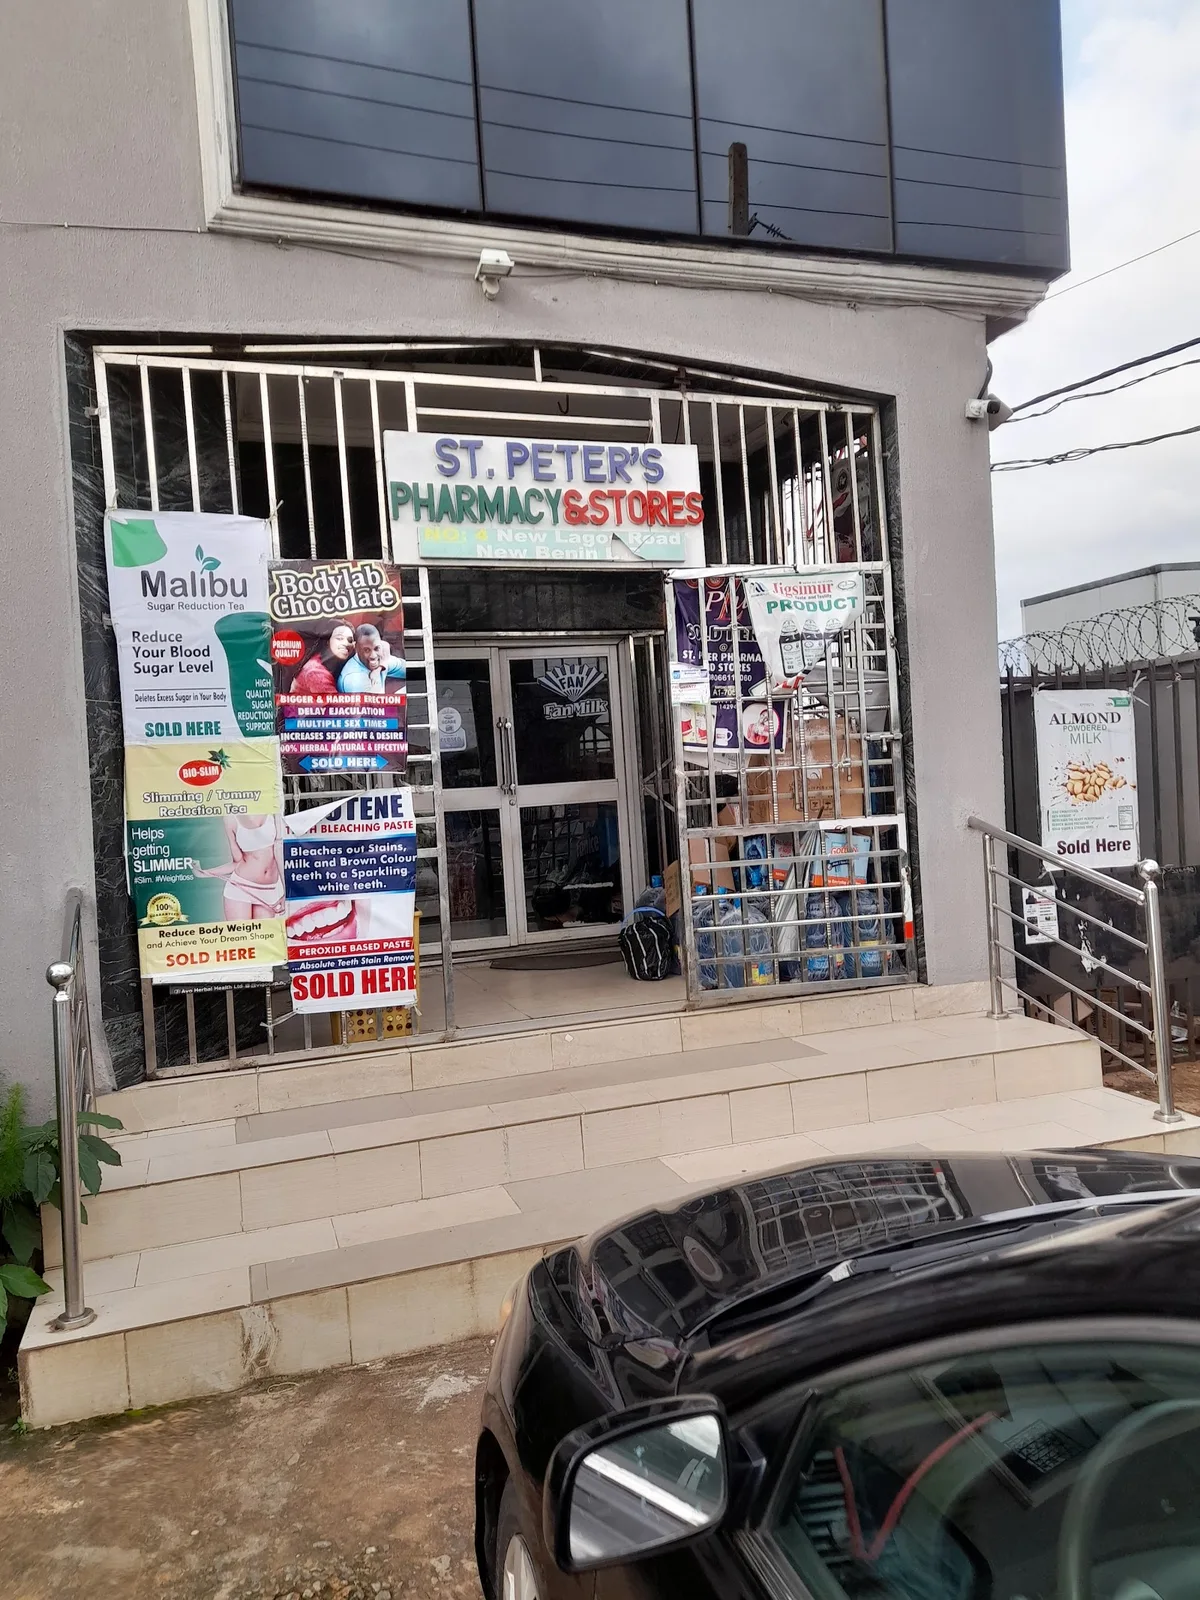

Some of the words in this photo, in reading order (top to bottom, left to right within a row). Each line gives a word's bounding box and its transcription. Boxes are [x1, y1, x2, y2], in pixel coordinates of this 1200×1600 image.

[435, 438, 494, 479] ST.
[505, 441, 665, 483] PETER'S
[475, 528, 488, 541] 4
[497, 529, 548, 543] New
[628, 533, 681, 545] Road
[477, 544, 529, 558] New
[536, 547, 598, 560] Benin
[140, 570, 248, 598] Malibu
[279, 566, 381, 597] Bodylab
[147, 602, 175, 612] Sugar
[178, 602, 226, 611] Reduction
[228, 602, 245, 611] Tea
[273, 588, 394, 618] Chocolate
[766, 597, 858, 614] PRODUCT
[132, 630, 183, 643] Reduce
[272, 640, 302, 649] PREMIUM
[132, 646, 167, 659] Your
[170, 645, 211, 658] Blood
[275, 650, 300, 659] QUALITY
[682, 650, 695, 659] ST.
[133, 661, 176, 677] Sugar
[179, 661, 214, 673] Level
[255, 679, 271, 687] HIGH
[559, 675, 585, 690] FAN
[135, 693, 156, 703] Deletes
[157, 693, 174, 702] Excess
[175, 693, 191, 704] Sugar
[192, 693, 198, 701] in
[200, 693, 213, 701] Your
[213, 692, 227, 703] Body
[245, 690, 272, 699] QUALITY
[280, 695, 314, 704] BIGGER
[326, 695, 361, 704] HARDER
[364, 696, 401, 704] ERECTION
[251, 701, 273, 709] SUGAR
[297, 707, 326, 716] DELAY
[329, 707, 385, 716] EJACULATION
[238, 712, 274, 720] REDUCTION
[1049, 712, 1121, 725] ALMOND
[144, 722, 183, 738] SOLD
[186, 721, 222, 736] HERE
[246, 722, 274, 731] SUPPORT
[296, 719, 342, 728] MULTIPLE
[344, 719, 360, 728] SEX
[363, 720, 387, 728] TIMES
[280, 732, 324, 741] INCREASES
[326, 732, 341, 740] SEX
[343, 732, 367, 740] DRIVE
[369, 732, 374, 740] &
[376, 732, 403, 740] DESIRE
[1070, 733, 1102, 744] MILK
[300, 743, 329, 752] HERBAL
[331, 743, 365, 751] NATURAL
[367, 743, 372, 751] &
[311, 757, 343, 768] SOLD
[346, 757, 378, 768] HERE
[182, 766, 219, 779] BIO-SLIM
[143, 791, 203, 803] Slimming
[215, 790, 261, 801] Tummy
[159, 805, 221, 817] Reduction
[225, 804, 248, 814] Tea
[321, 823, 382, 833] BLEACHING
[384, 821, 414, 831] PASTE
[132, 827, 164, 842] Helps
[132, 844, 170, 859] getting
[290, 846, 342, 857] Bleaches
[346, 845, 365, 854] out
[368, 842, 407, 853] Stains,
[1057, 839, 1090, 855] Sold
[1096, 838, 1131, 853] Here
[133, 858, 193, 873] SLIMMER
[284, 859, 309, 869] Milk
[314, 857, 336, 868] and
[340, 856, 376, 866] Brown
[380, 854, 417, 864] Colour
[291, 870, 322, 881] teeth
[326, 871, 336, 879] to
[340, 871, 348, 879] a
[351, 866, 408, 879] Sparkling
[318, 881, 350, 892] white
[353, 879, 387, 890] teeth.
[159, 928, 195, 938] Reduce
[199, 926, 224, 937] Body
[226, 923, 262, 934] Weight
[146, 941, 163, 949] and
[165, 938, 197, 948] Achieve
[200, 936, 217, 945] Your
[220, 934, 248, 943] Dream
[250, 932, 275, 941] Shape
[299, 945, 348, 956] PEROXIDE
[350, 942, 380, 952] BASED
[382, 940, 410, 950] PASTE
[166, 950, 210, 967] SOLD
[216, 948, 256, 962] HERE
[337, 959, 359, 968] Teeth
[361, 956, 381, 966] Stain
[292, 971, 355, 1001] SOLD
